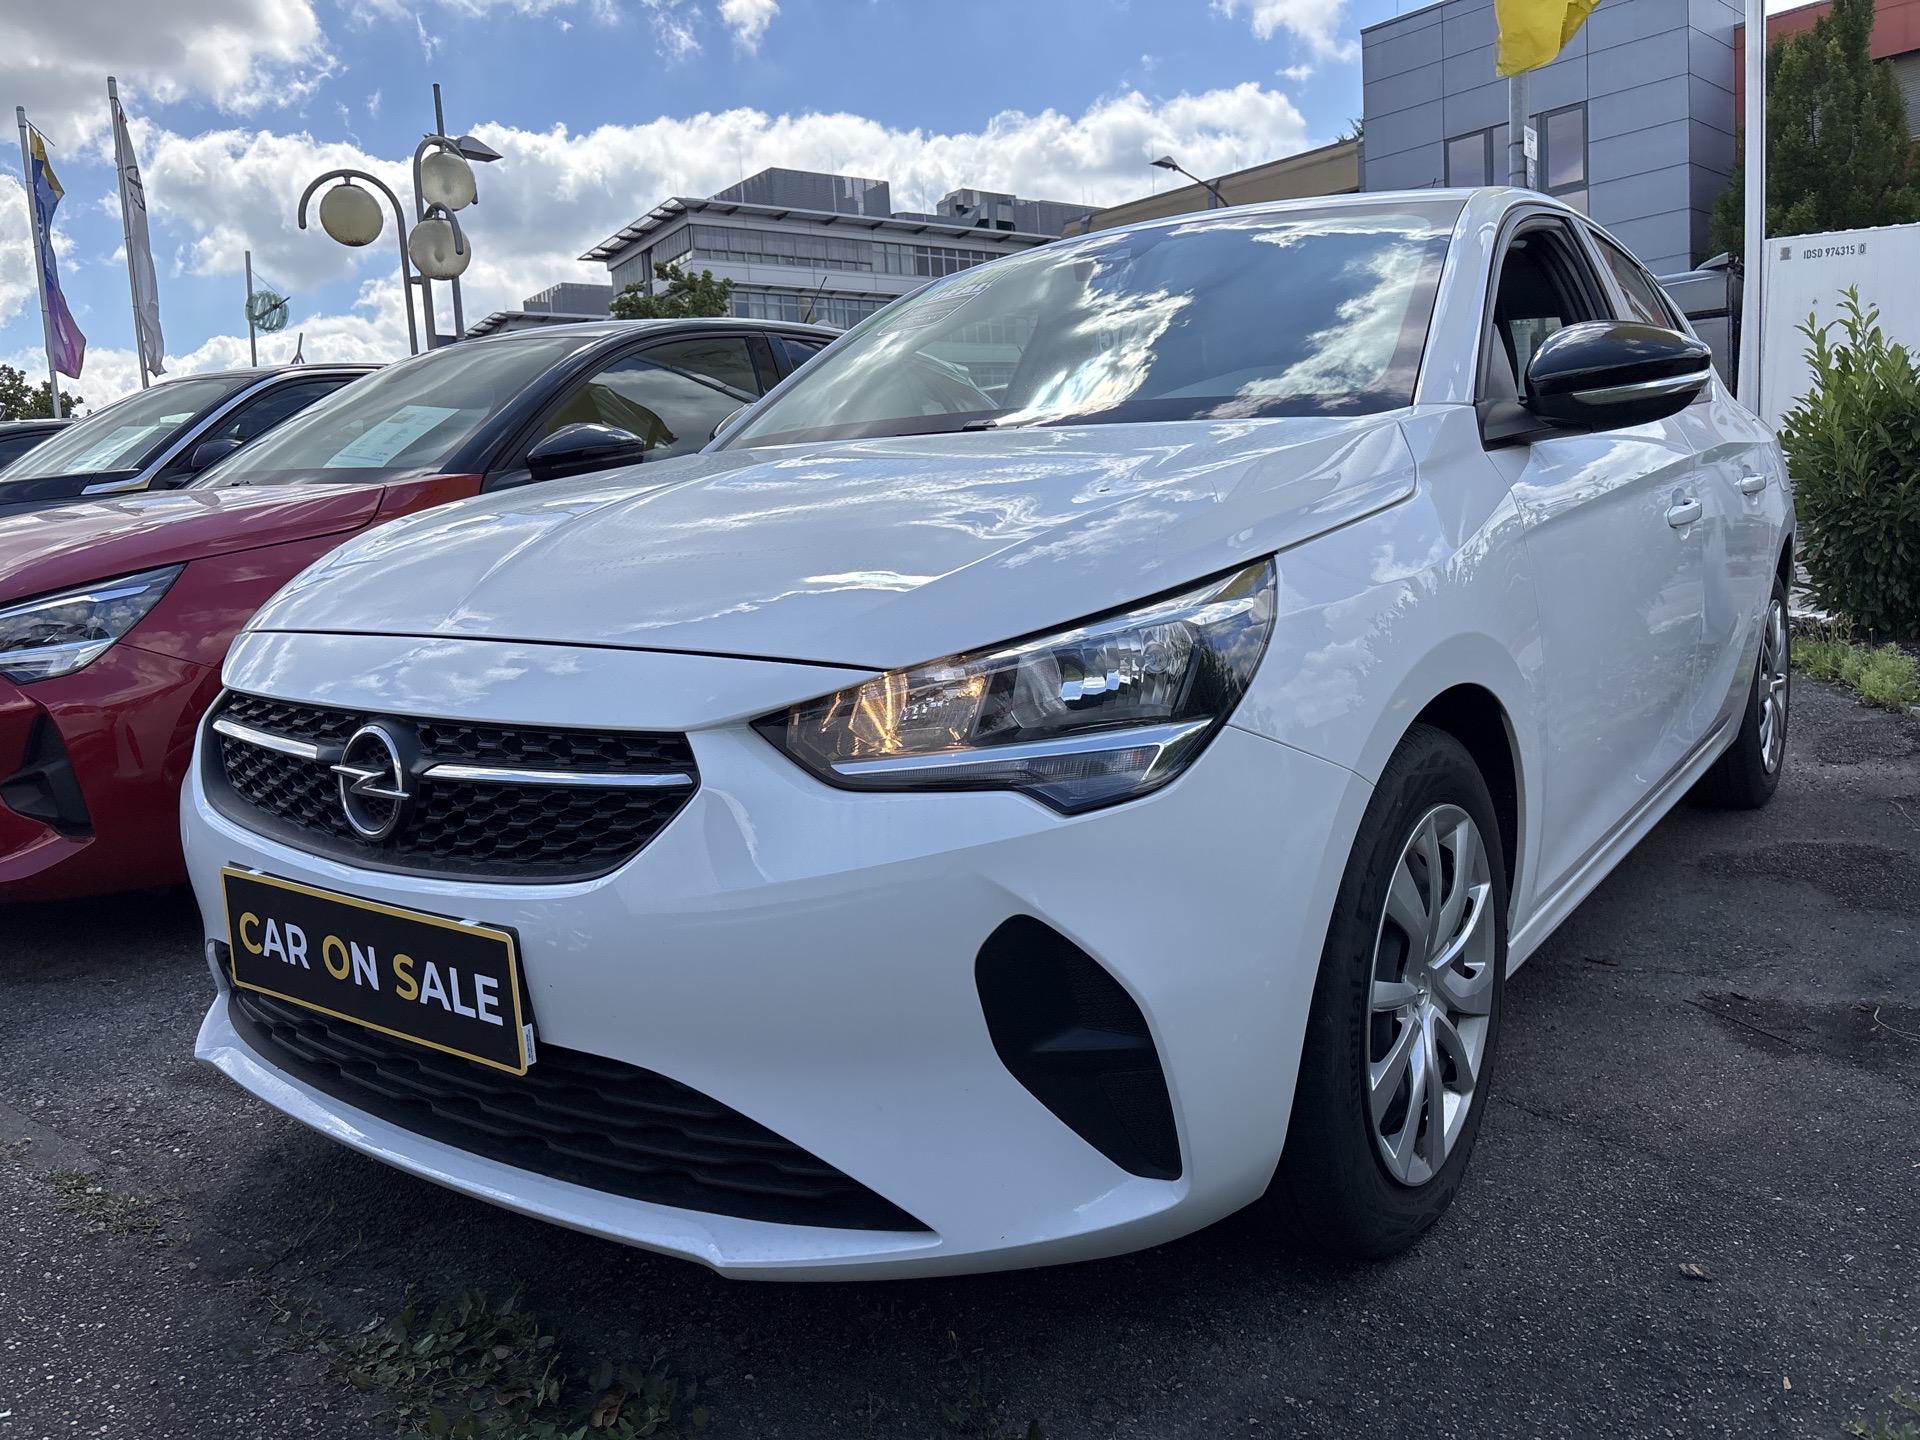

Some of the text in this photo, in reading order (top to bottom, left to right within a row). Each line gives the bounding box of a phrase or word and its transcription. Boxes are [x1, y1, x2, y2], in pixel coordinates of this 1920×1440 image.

[1803, 243, 1866, 260] IDSD 974315 0
[239, 911, 504, 1027] CAR ON SALE
